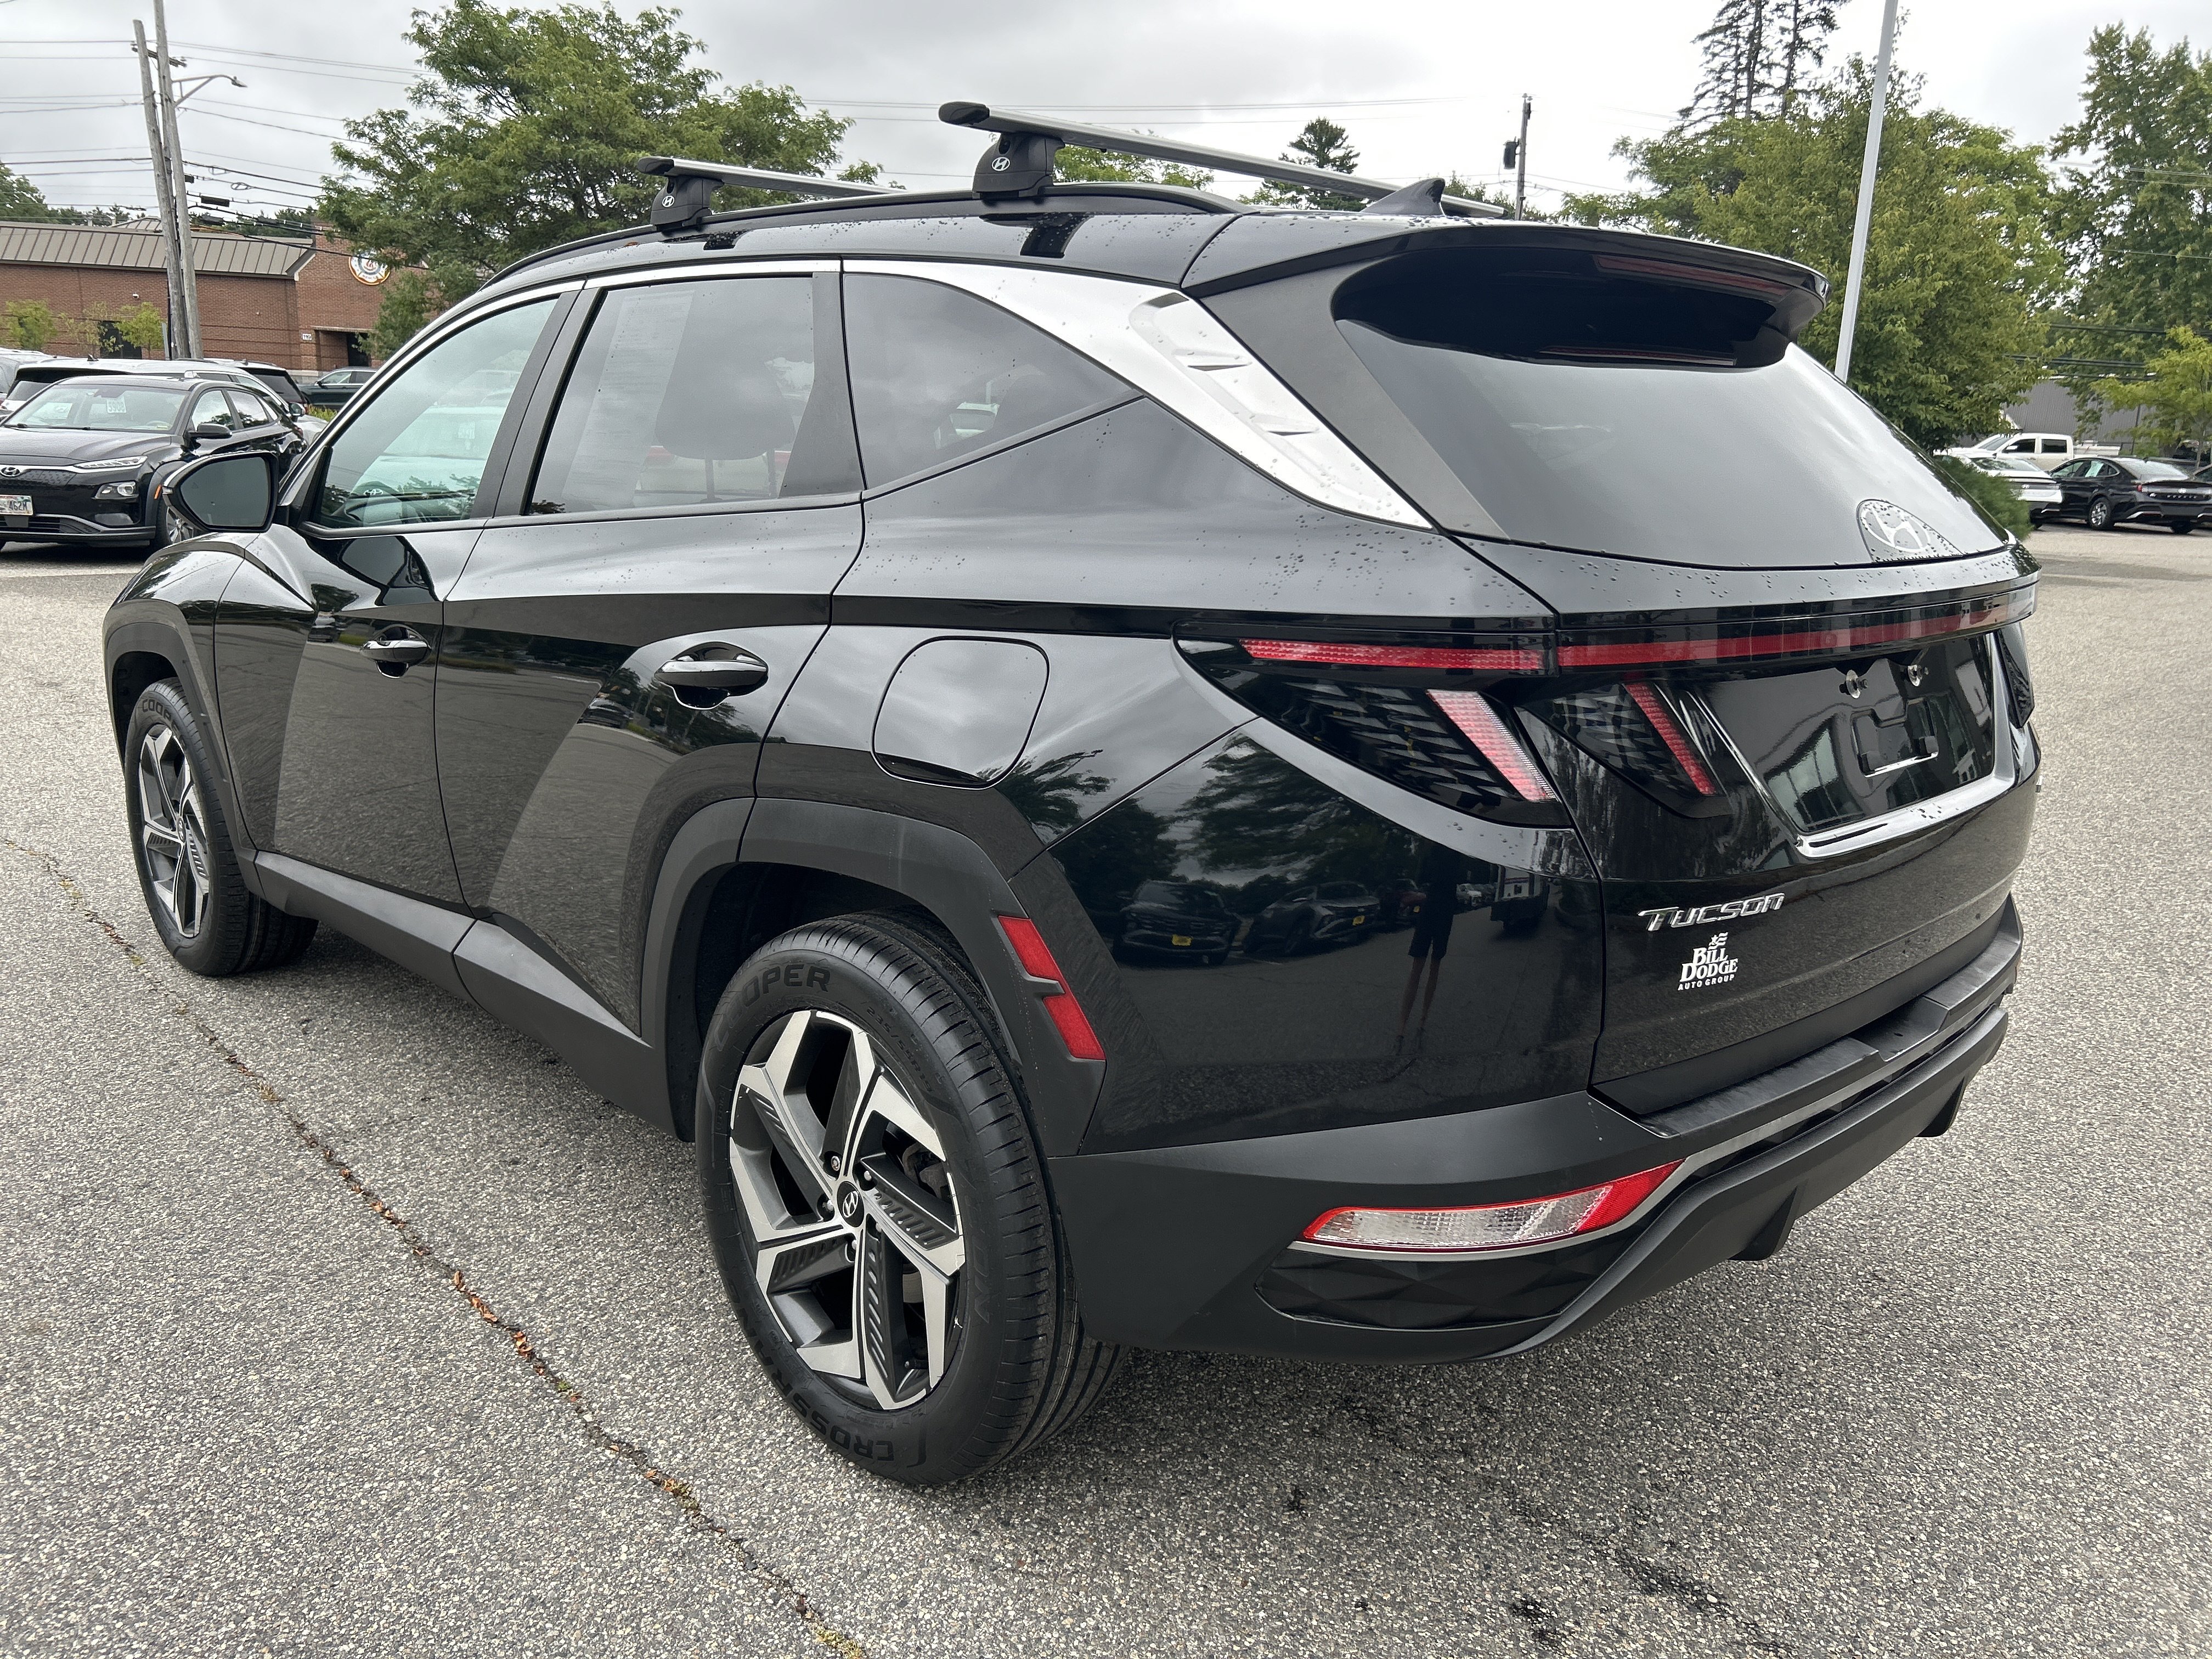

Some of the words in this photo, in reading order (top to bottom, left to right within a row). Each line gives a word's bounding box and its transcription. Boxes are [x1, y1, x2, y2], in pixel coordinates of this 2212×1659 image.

[1638, 893, 1785, 931] TUCSON
[1692, 947, 1728, 966] BILL
[1679, 958, 1739, 982] DODGE
[1677, 980, 1702, 991] AUTO
[1705, 974, 1735, 986] GROUP
